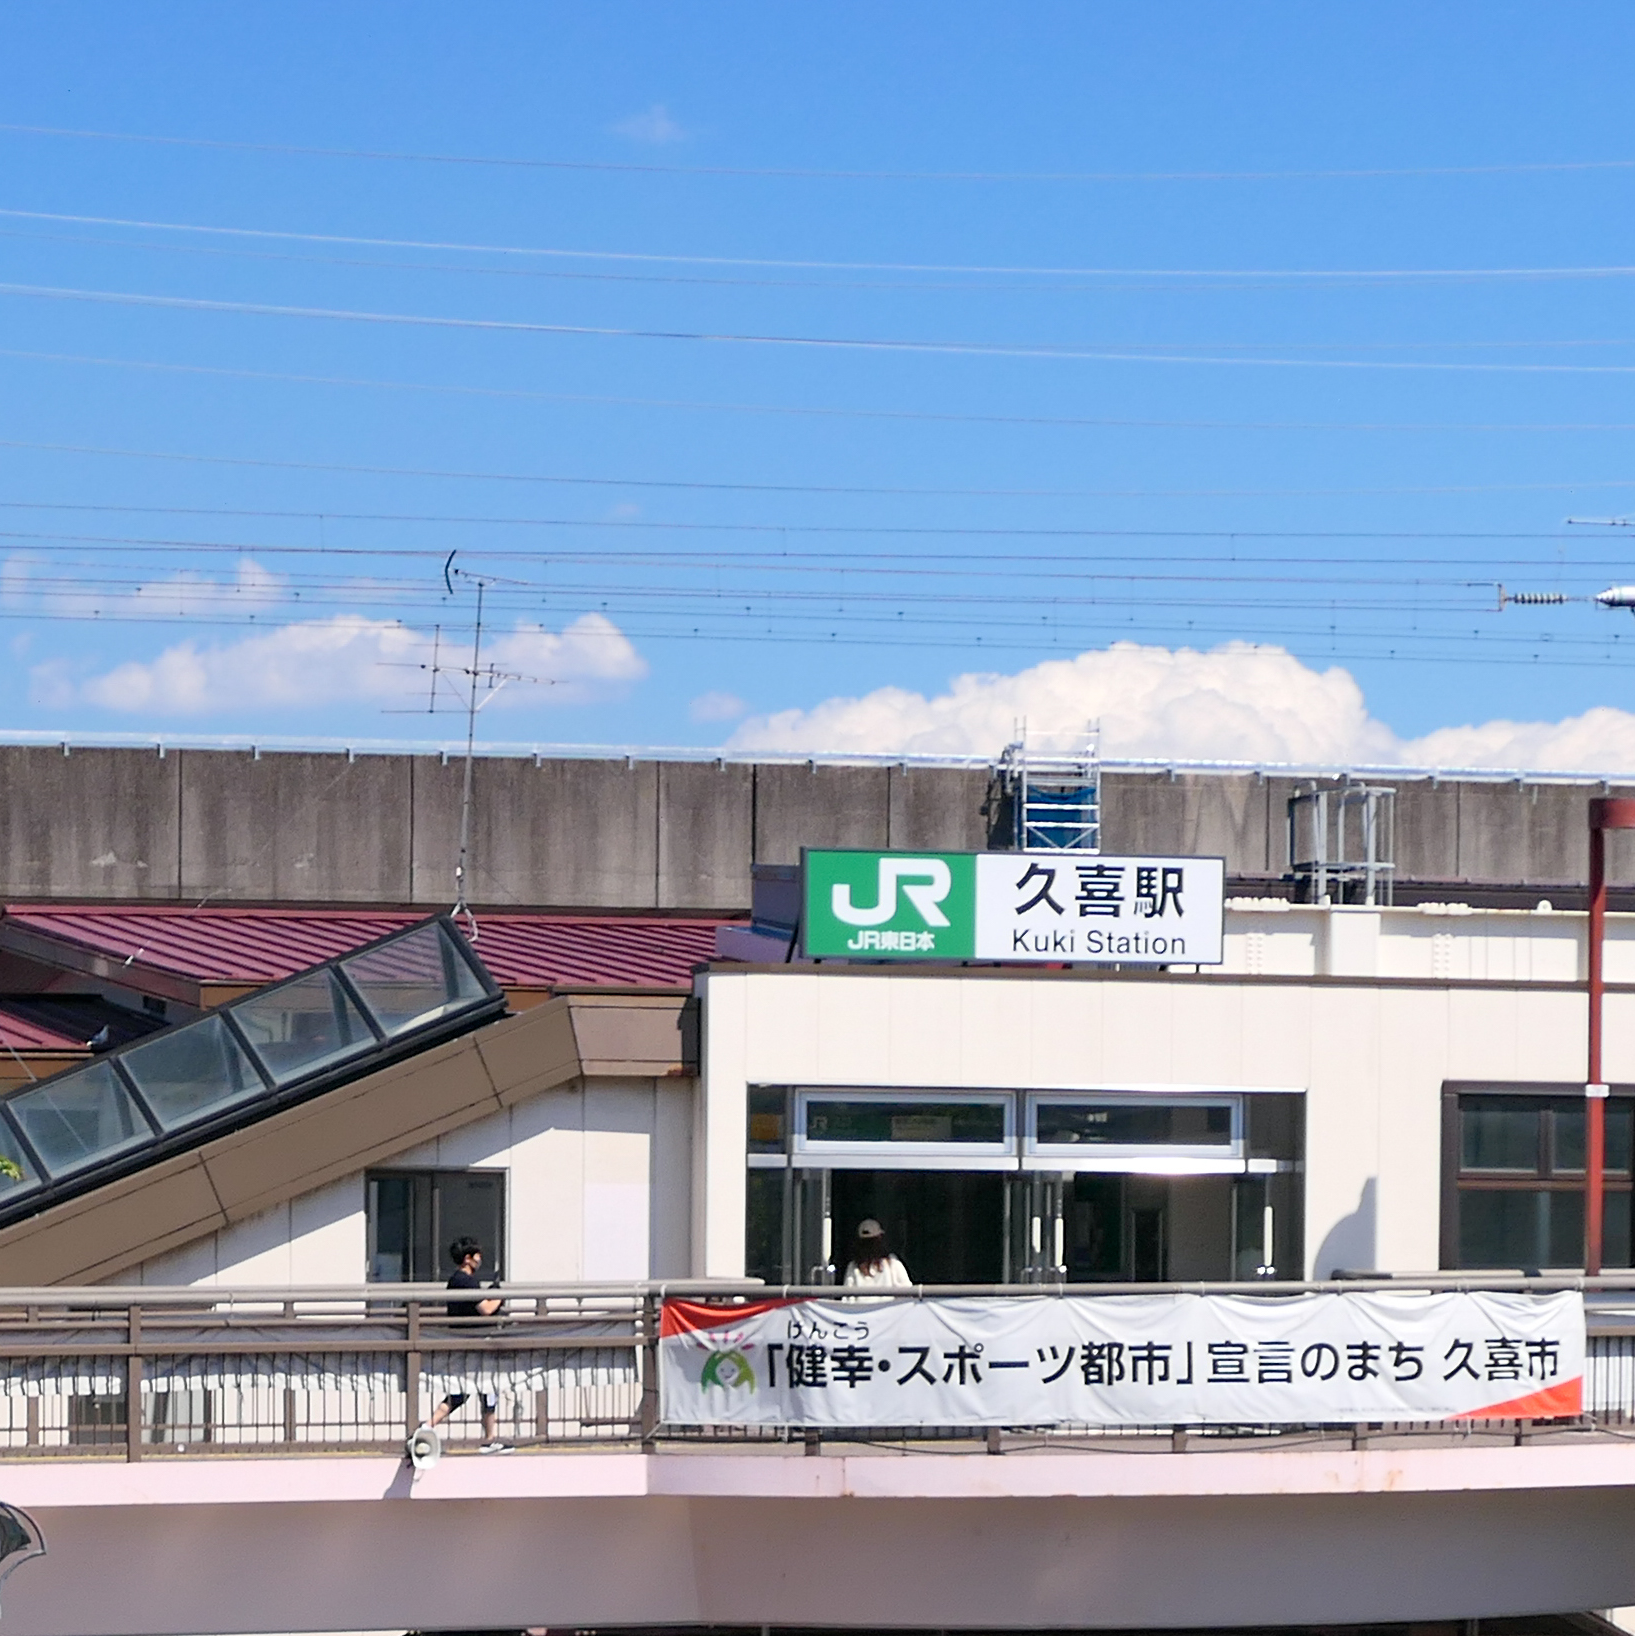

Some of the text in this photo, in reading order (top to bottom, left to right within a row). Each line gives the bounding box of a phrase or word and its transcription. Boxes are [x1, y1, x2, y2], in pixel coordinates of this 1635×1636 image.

[832, 857, 952, 927] JR
[1015, 862, 1185, 919] 久喜駅
[847, 930, 936, 952] JR東日本
[1013, 929, 1186, 955] Kuki Station
[787, 1320, 870, 1340] けんこう
[766, 1336, 1560, 1390] 「健幸・スポーツ都市」宣言のまち 久喜市
